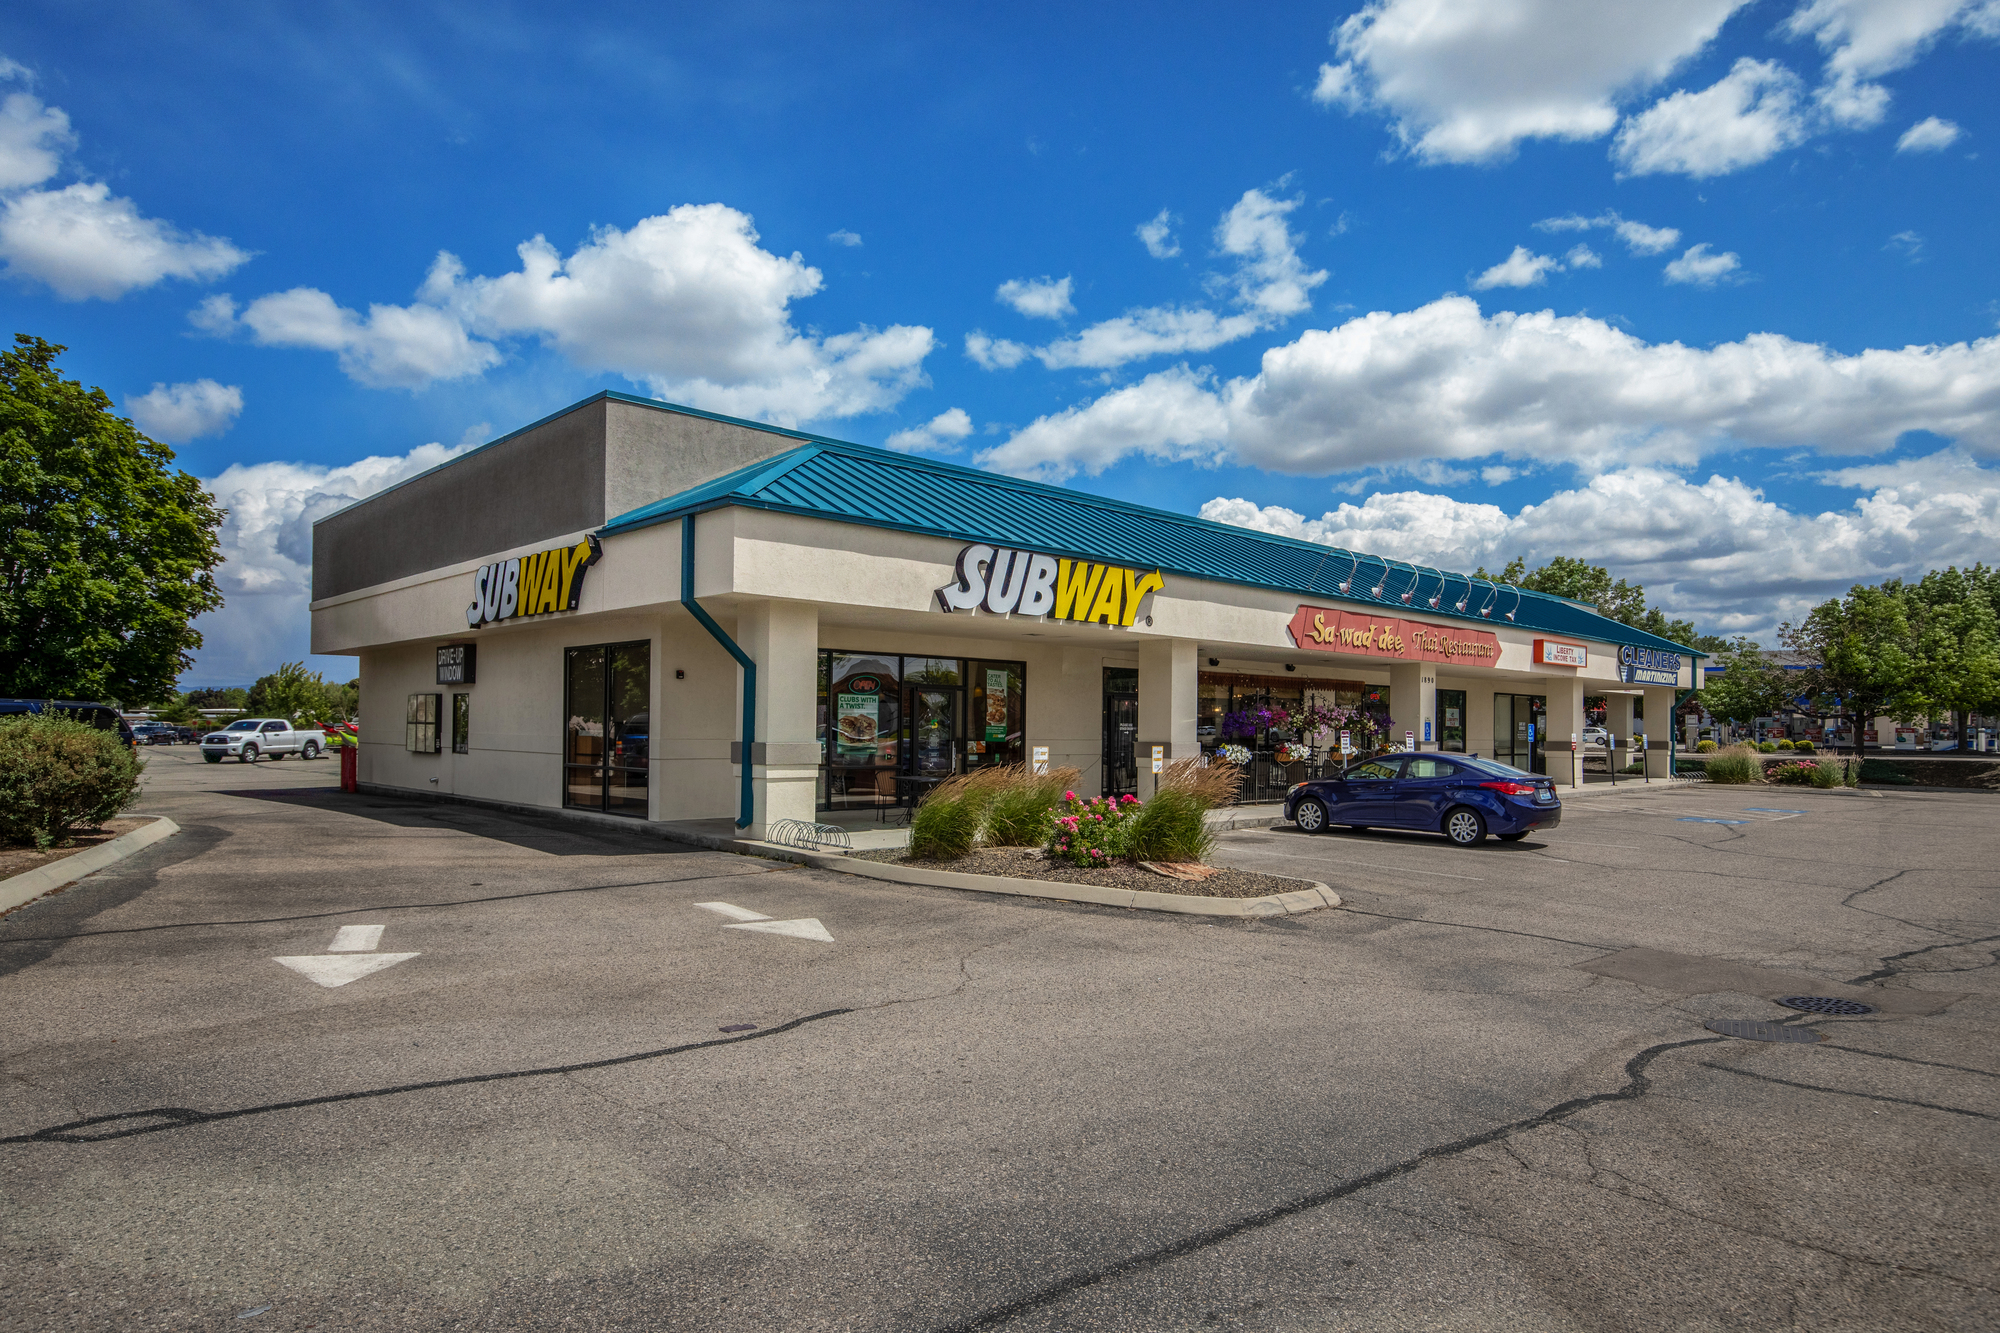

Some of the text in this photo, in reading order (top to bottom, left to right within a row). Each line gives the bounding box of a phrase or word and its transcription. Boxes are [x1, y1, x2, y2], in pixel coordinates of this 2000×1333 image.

[466, 535, 593, 624] SUBWAY
[941, 544, 1164, 627] SUBWAY
[1412, 629, 1438, 651] Thai
[1439, 635, 1494, 658] Restaurant
[1556, 645, 1574, 655] LIBERTY
[438, 647, 463, 665] DRIVE-UP
[1553, 654, 1568, 662] INCOME
[1622, 645, 1681, 671] CLEANERS
[439, 665, 462, 681] WINDOW
[1421, 676, 1434, 684] 1890
[1635, 670, 1676, 684] MARTINIZING
